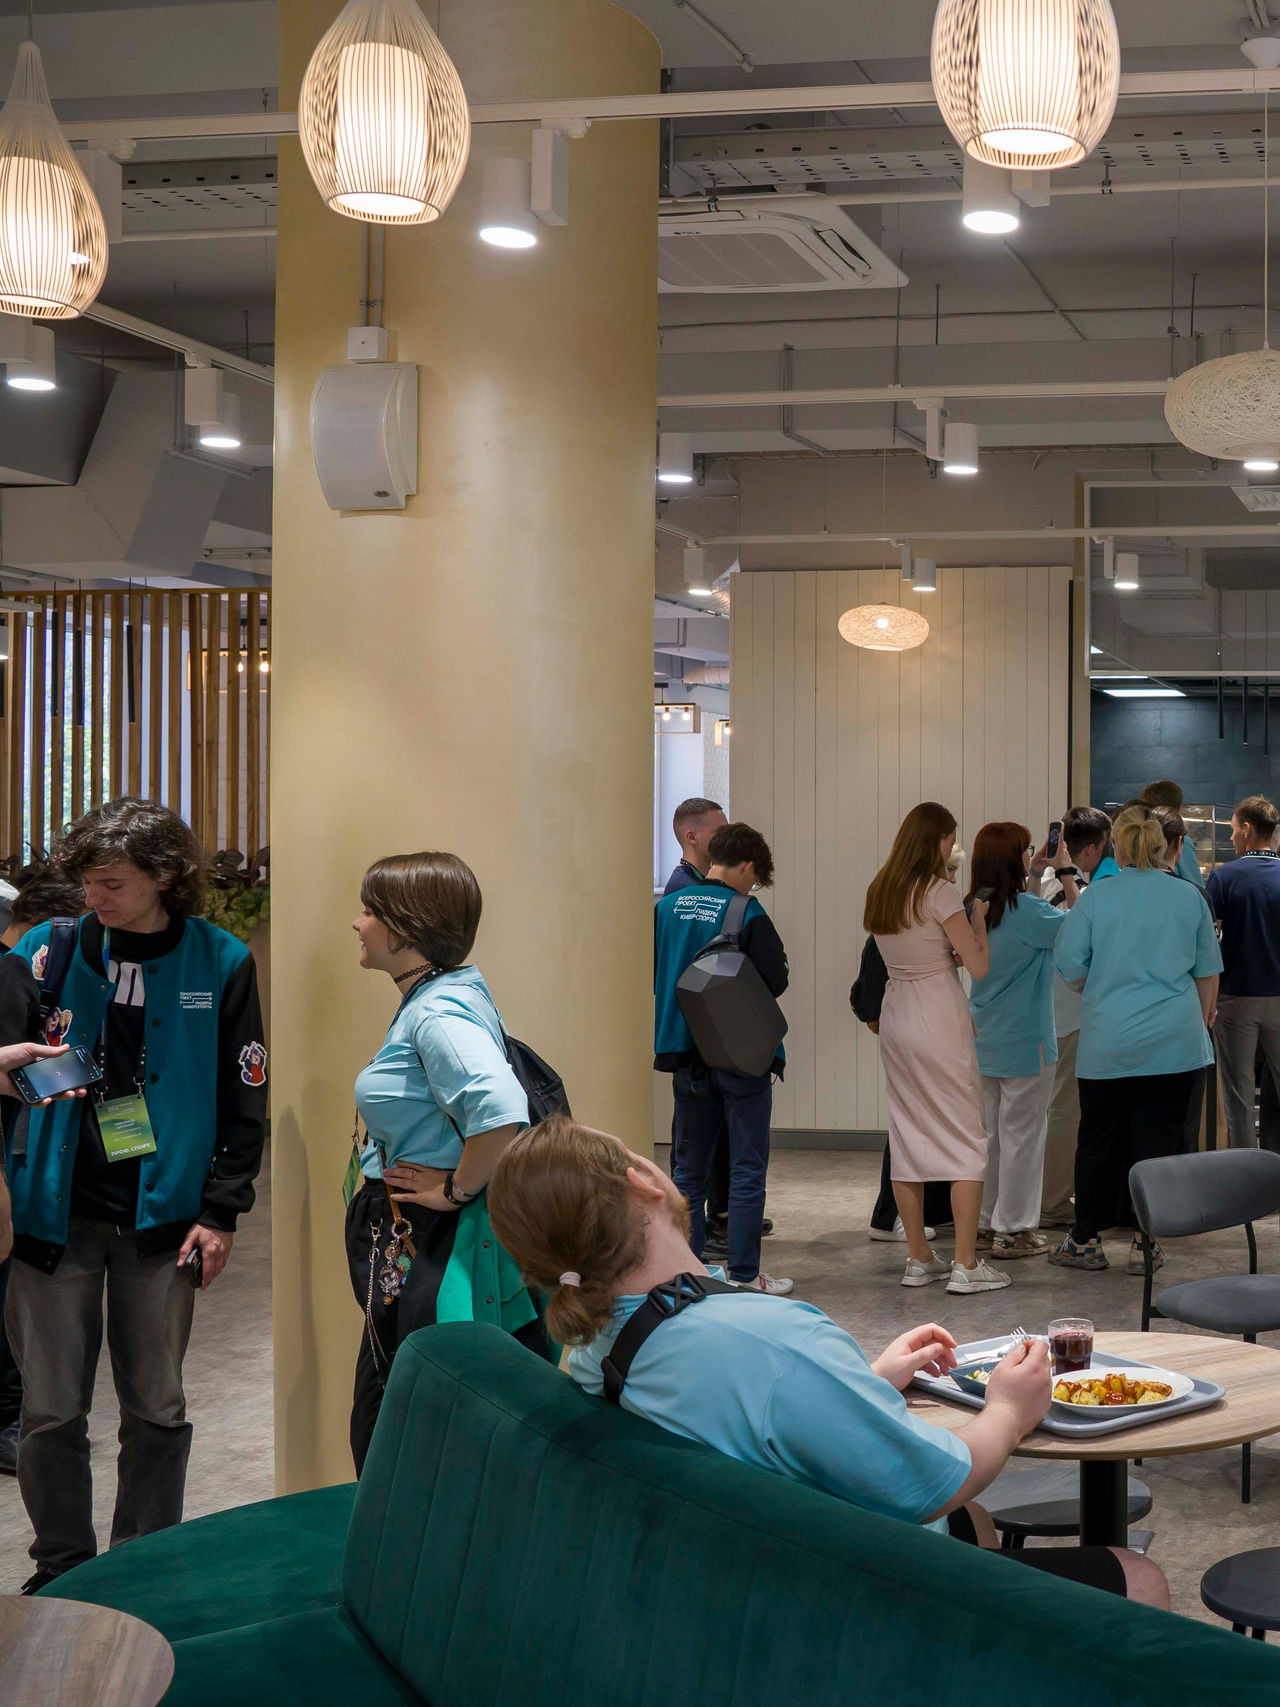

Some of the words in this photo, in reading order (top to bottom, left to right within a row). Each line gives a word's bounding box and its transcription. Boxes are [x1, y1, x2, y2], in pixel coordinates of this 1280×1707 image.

[678, 896, 726, 904] ВСЕРОССИЙСКИЙ
[695, 908, 718, 917] ЛИДЕРЫ
[680, 914, 716, 923] КИБЕРСПОРТА
[130, 1143, 151, 1151] СПОРТ
